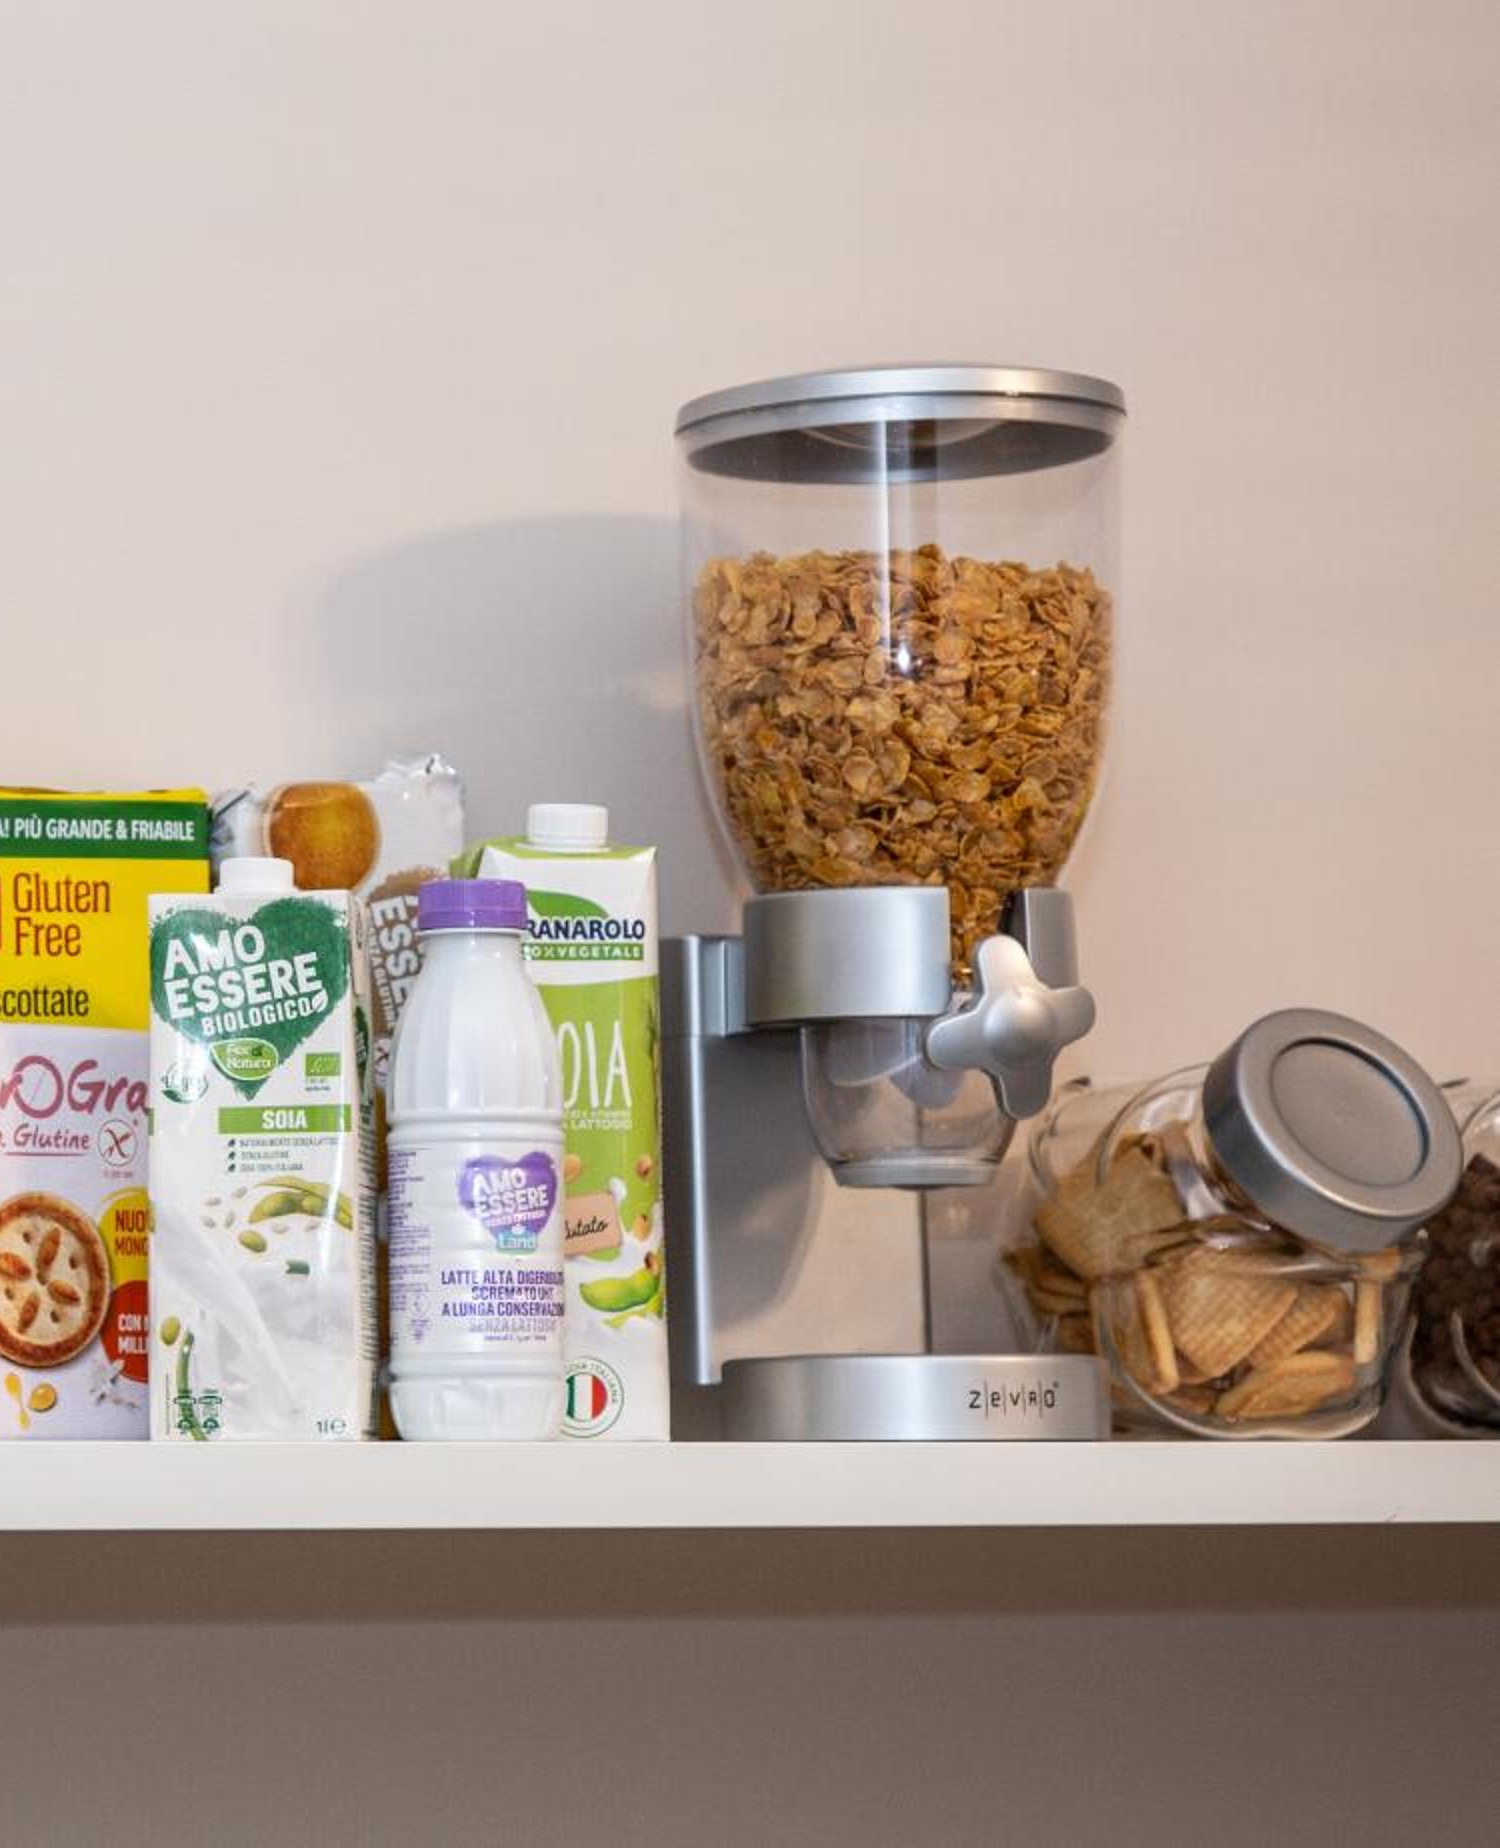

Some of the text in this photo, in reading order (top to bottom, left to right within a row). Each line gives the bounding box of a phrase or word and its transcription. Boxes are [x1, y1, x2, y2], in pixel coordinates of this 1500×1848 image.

[14, 813, 42, 839] PIÙ
[46, 820, 114, 841] GRANDE
[116, 821, 128, 841] &
[131, 820, 196, 842] FRIABILE
[13, 872, 111, 914] Gluten
[14, 917, 82, 957] Free
[527, 919, 646, 940] RANAROLO
[164, 925, 265, 981] AMO
[164, 951, 324, 1020] ESSERE
[201, 996, 315, 1038] BIOLOGICO
[558, 1021, 633, 1108] OIA
[261, 1109, 308, 1130] SOIA
[13, 1123, 92, 1150] Glutine
[473, 1167, 528, 1196] AMO
[474, 1184, 549, 1219] ESSERE
[483, 1269, 514, 1285] ALTA
[441, 1302, 451, 1316] A
[452, 1302, 495, 1317] LUNGA
